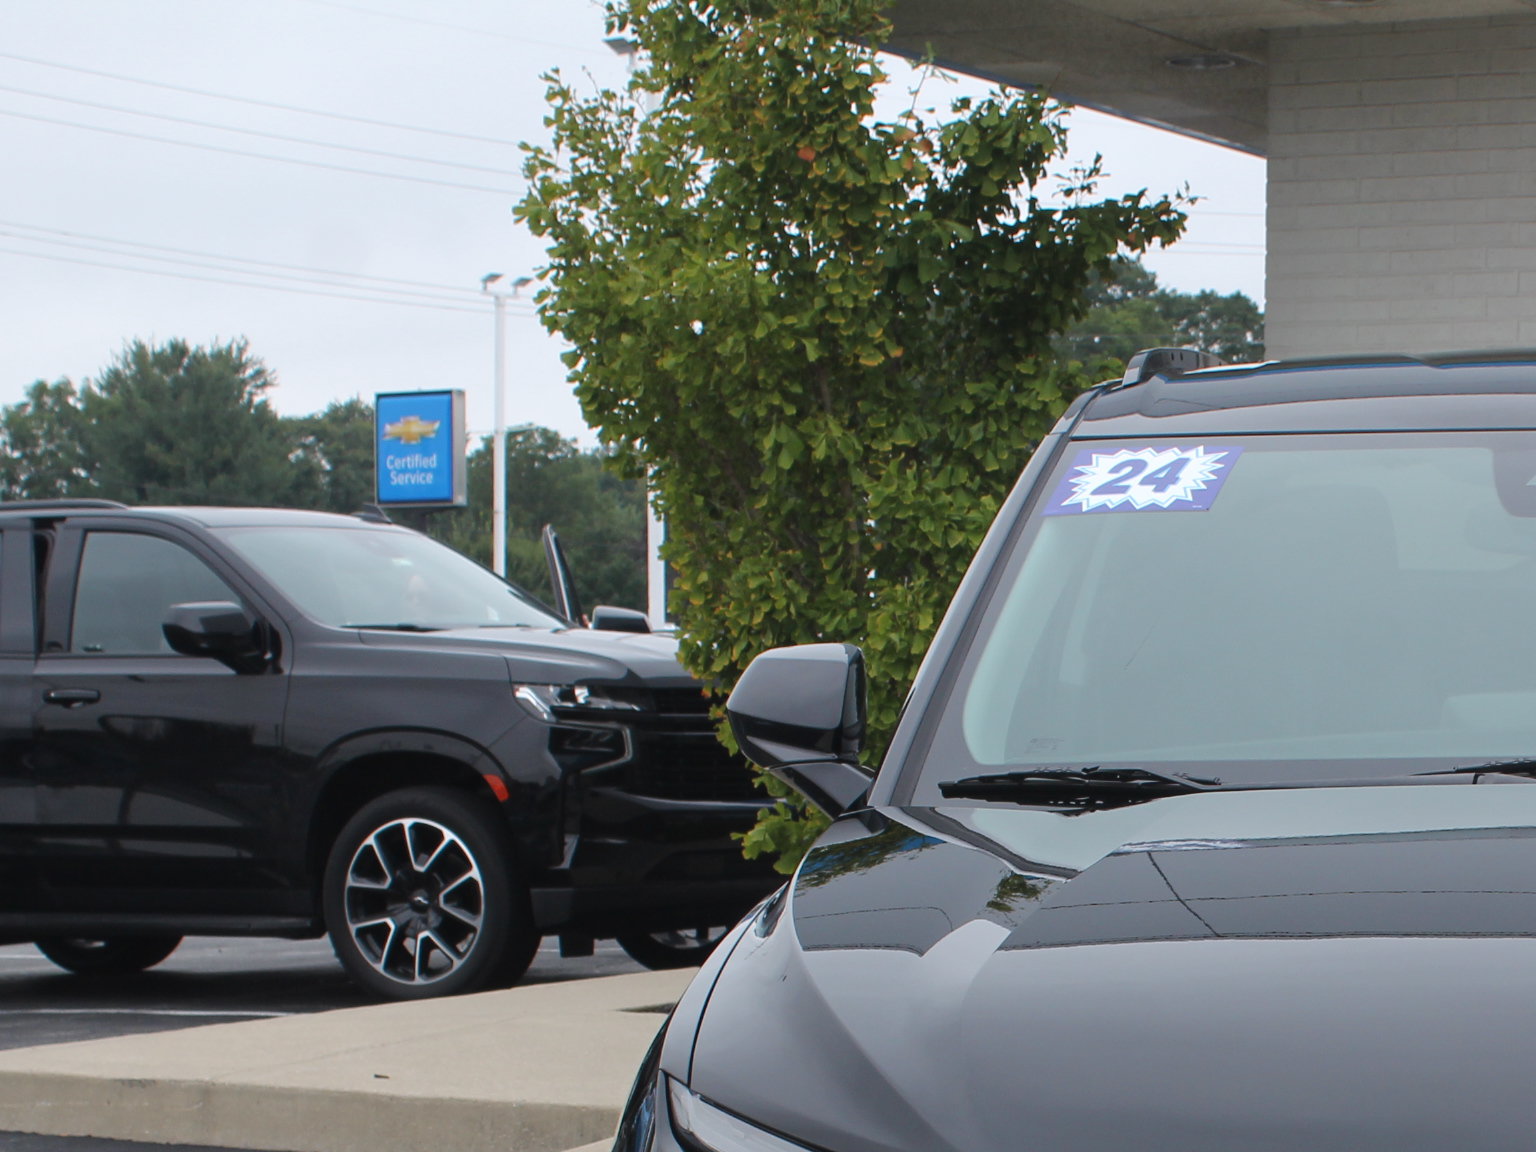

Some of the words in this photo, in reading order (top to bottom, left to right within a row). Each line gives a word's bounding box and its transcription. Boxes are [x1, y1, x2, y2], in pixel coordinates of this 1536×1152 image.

[386, 453, 437, 469] Certified
[390, 471, 434, 485] Service
[1090, 457, 1193, 496] 24
